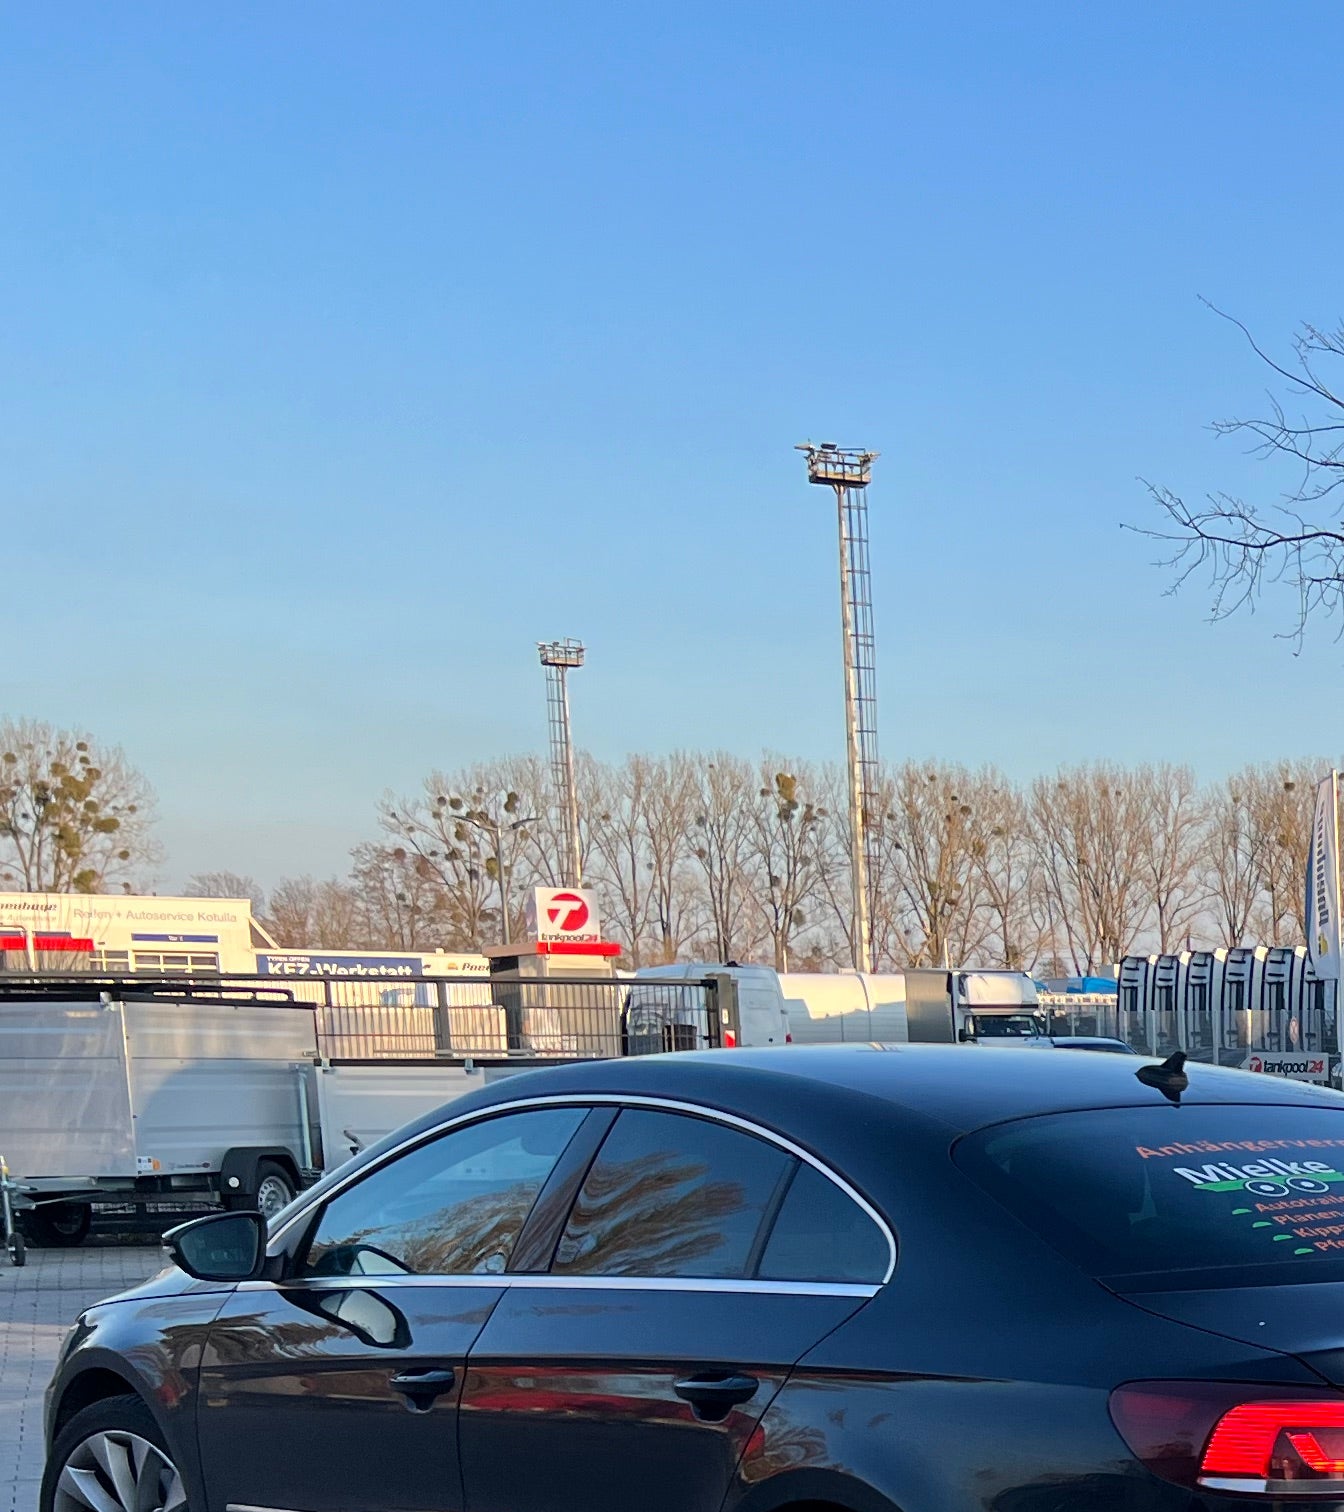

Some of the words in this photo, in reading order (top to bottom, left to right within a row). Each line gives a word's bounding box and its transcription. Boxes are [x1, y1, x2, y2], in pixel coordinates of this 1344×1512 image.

[126, 909, 194, 922] Autoservice
[198, 911, 237, 923] Kotulla
[1264, 1060, 1324, 1076] tankpool24
[1173, 1158, 1336, 1184] Mielke
